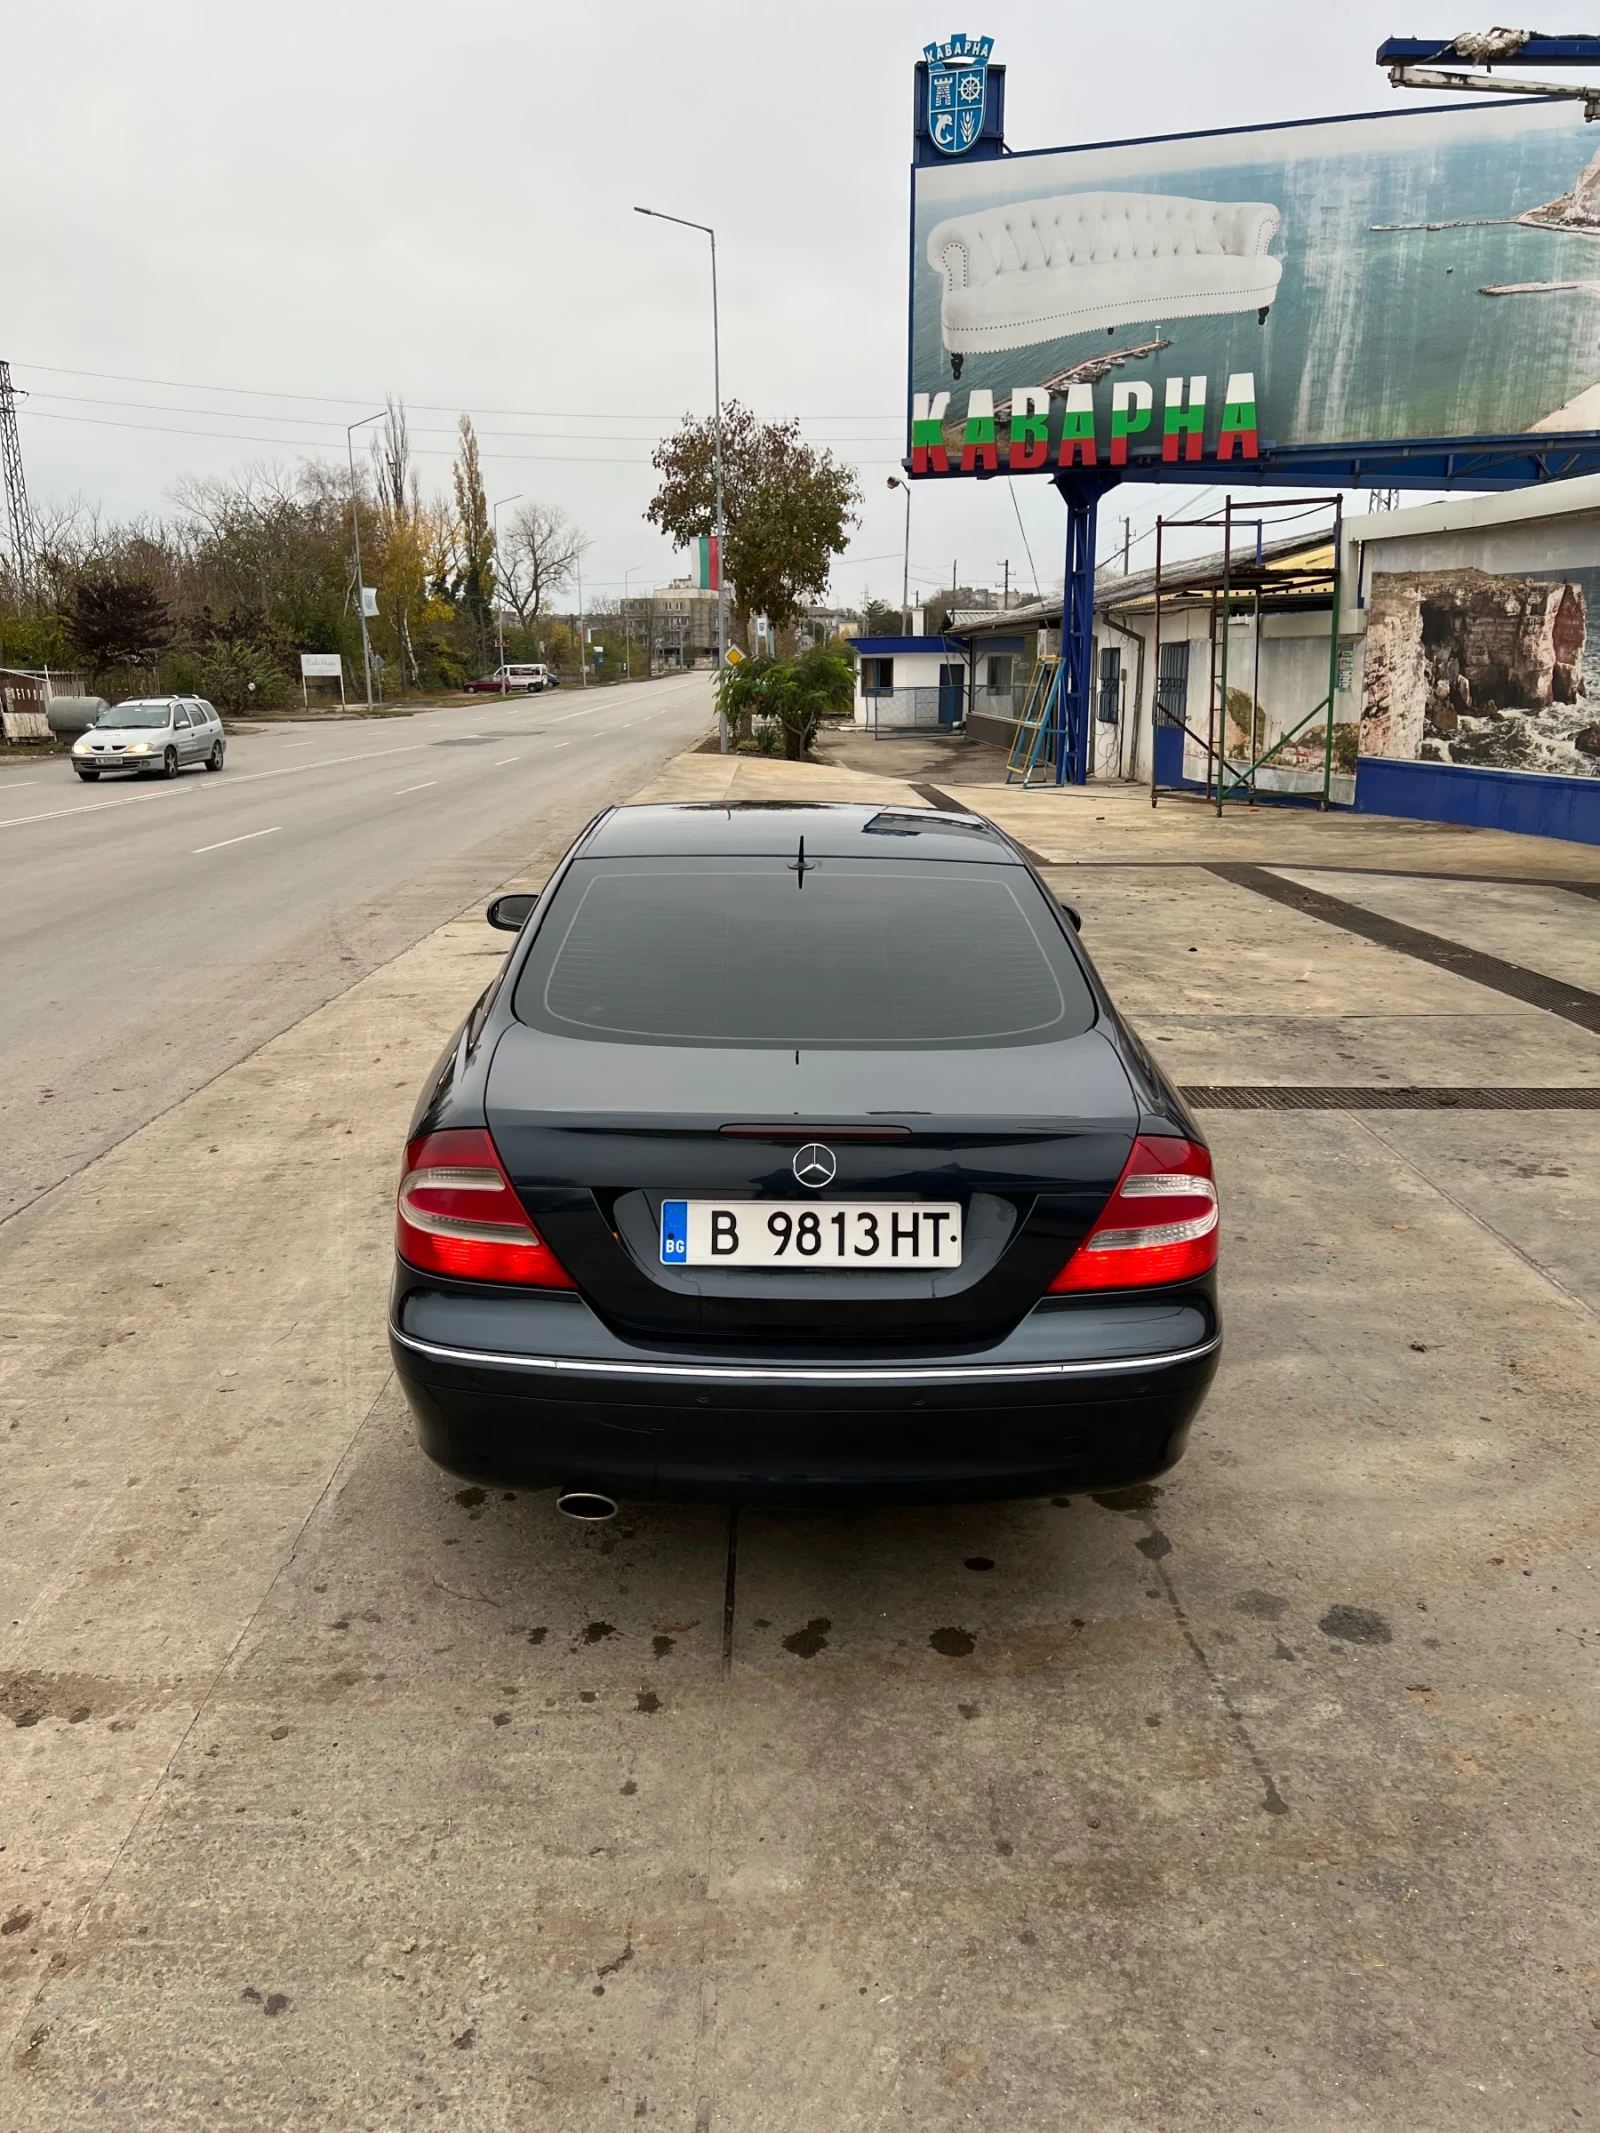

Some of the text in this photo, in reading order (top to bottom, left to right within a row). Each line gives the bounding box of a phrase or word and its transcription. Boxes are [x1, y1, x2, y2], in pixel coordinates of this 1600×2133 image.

[926, 41, 989, 63] КАВАРНА
[912, 372, 1259, 473] КАВАРНА
[665, 1240, 685, 1254] BG
[711, 1210, 739, 1255] B
